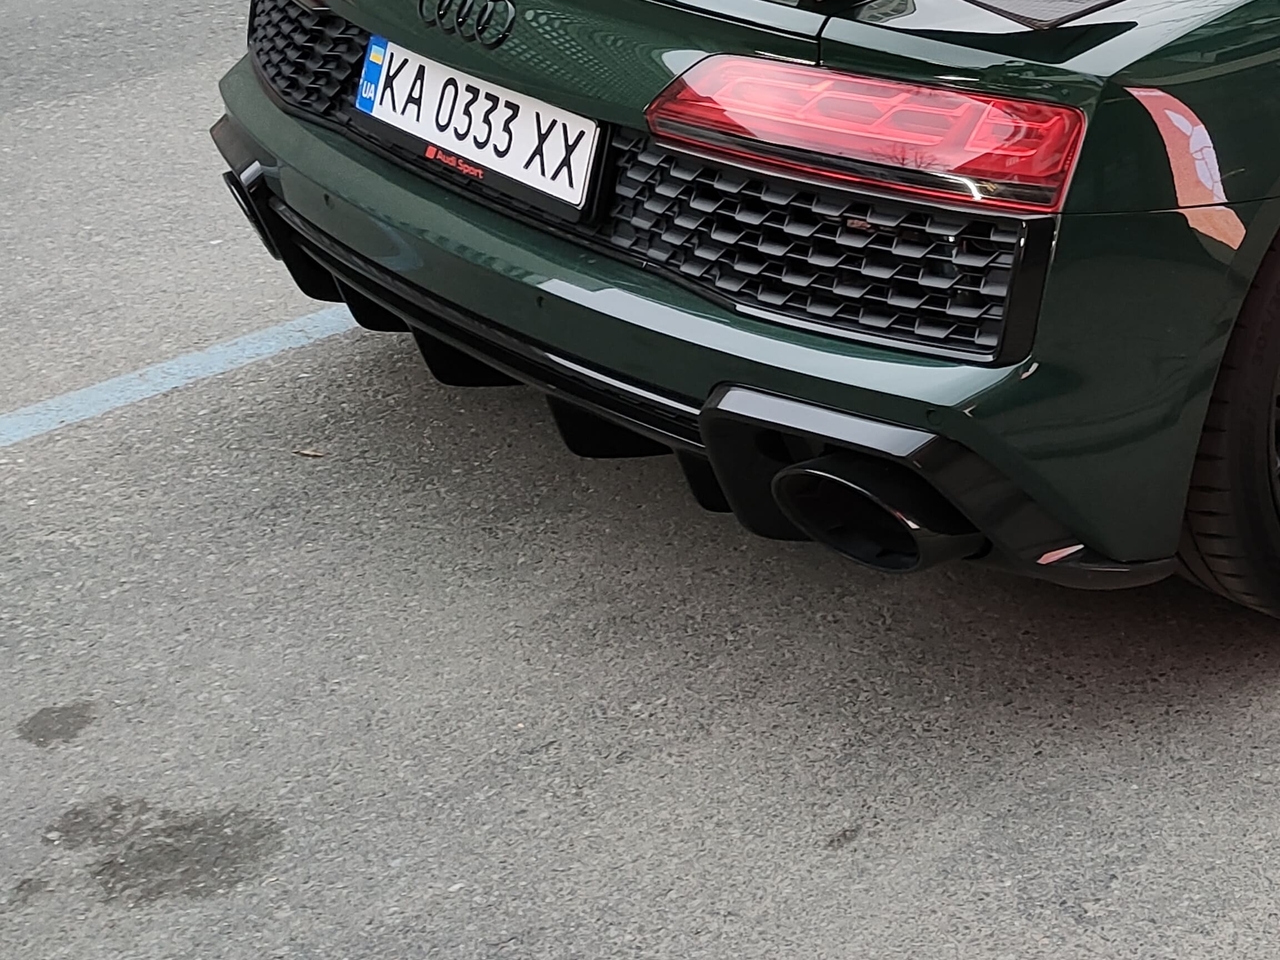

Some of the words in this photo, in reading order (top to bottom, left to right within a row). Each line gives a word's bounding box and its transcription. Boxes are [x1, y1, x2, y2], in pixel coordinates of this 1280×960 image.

[361, 80, 376, 100] UA
[379, 52, 426, 123] KA
[435, 76, 520, 159] 0333
[523, 111, 586, 189] XX
[436, 150, 457, 167] Audi
[456, 159, 484, 179] Sport
